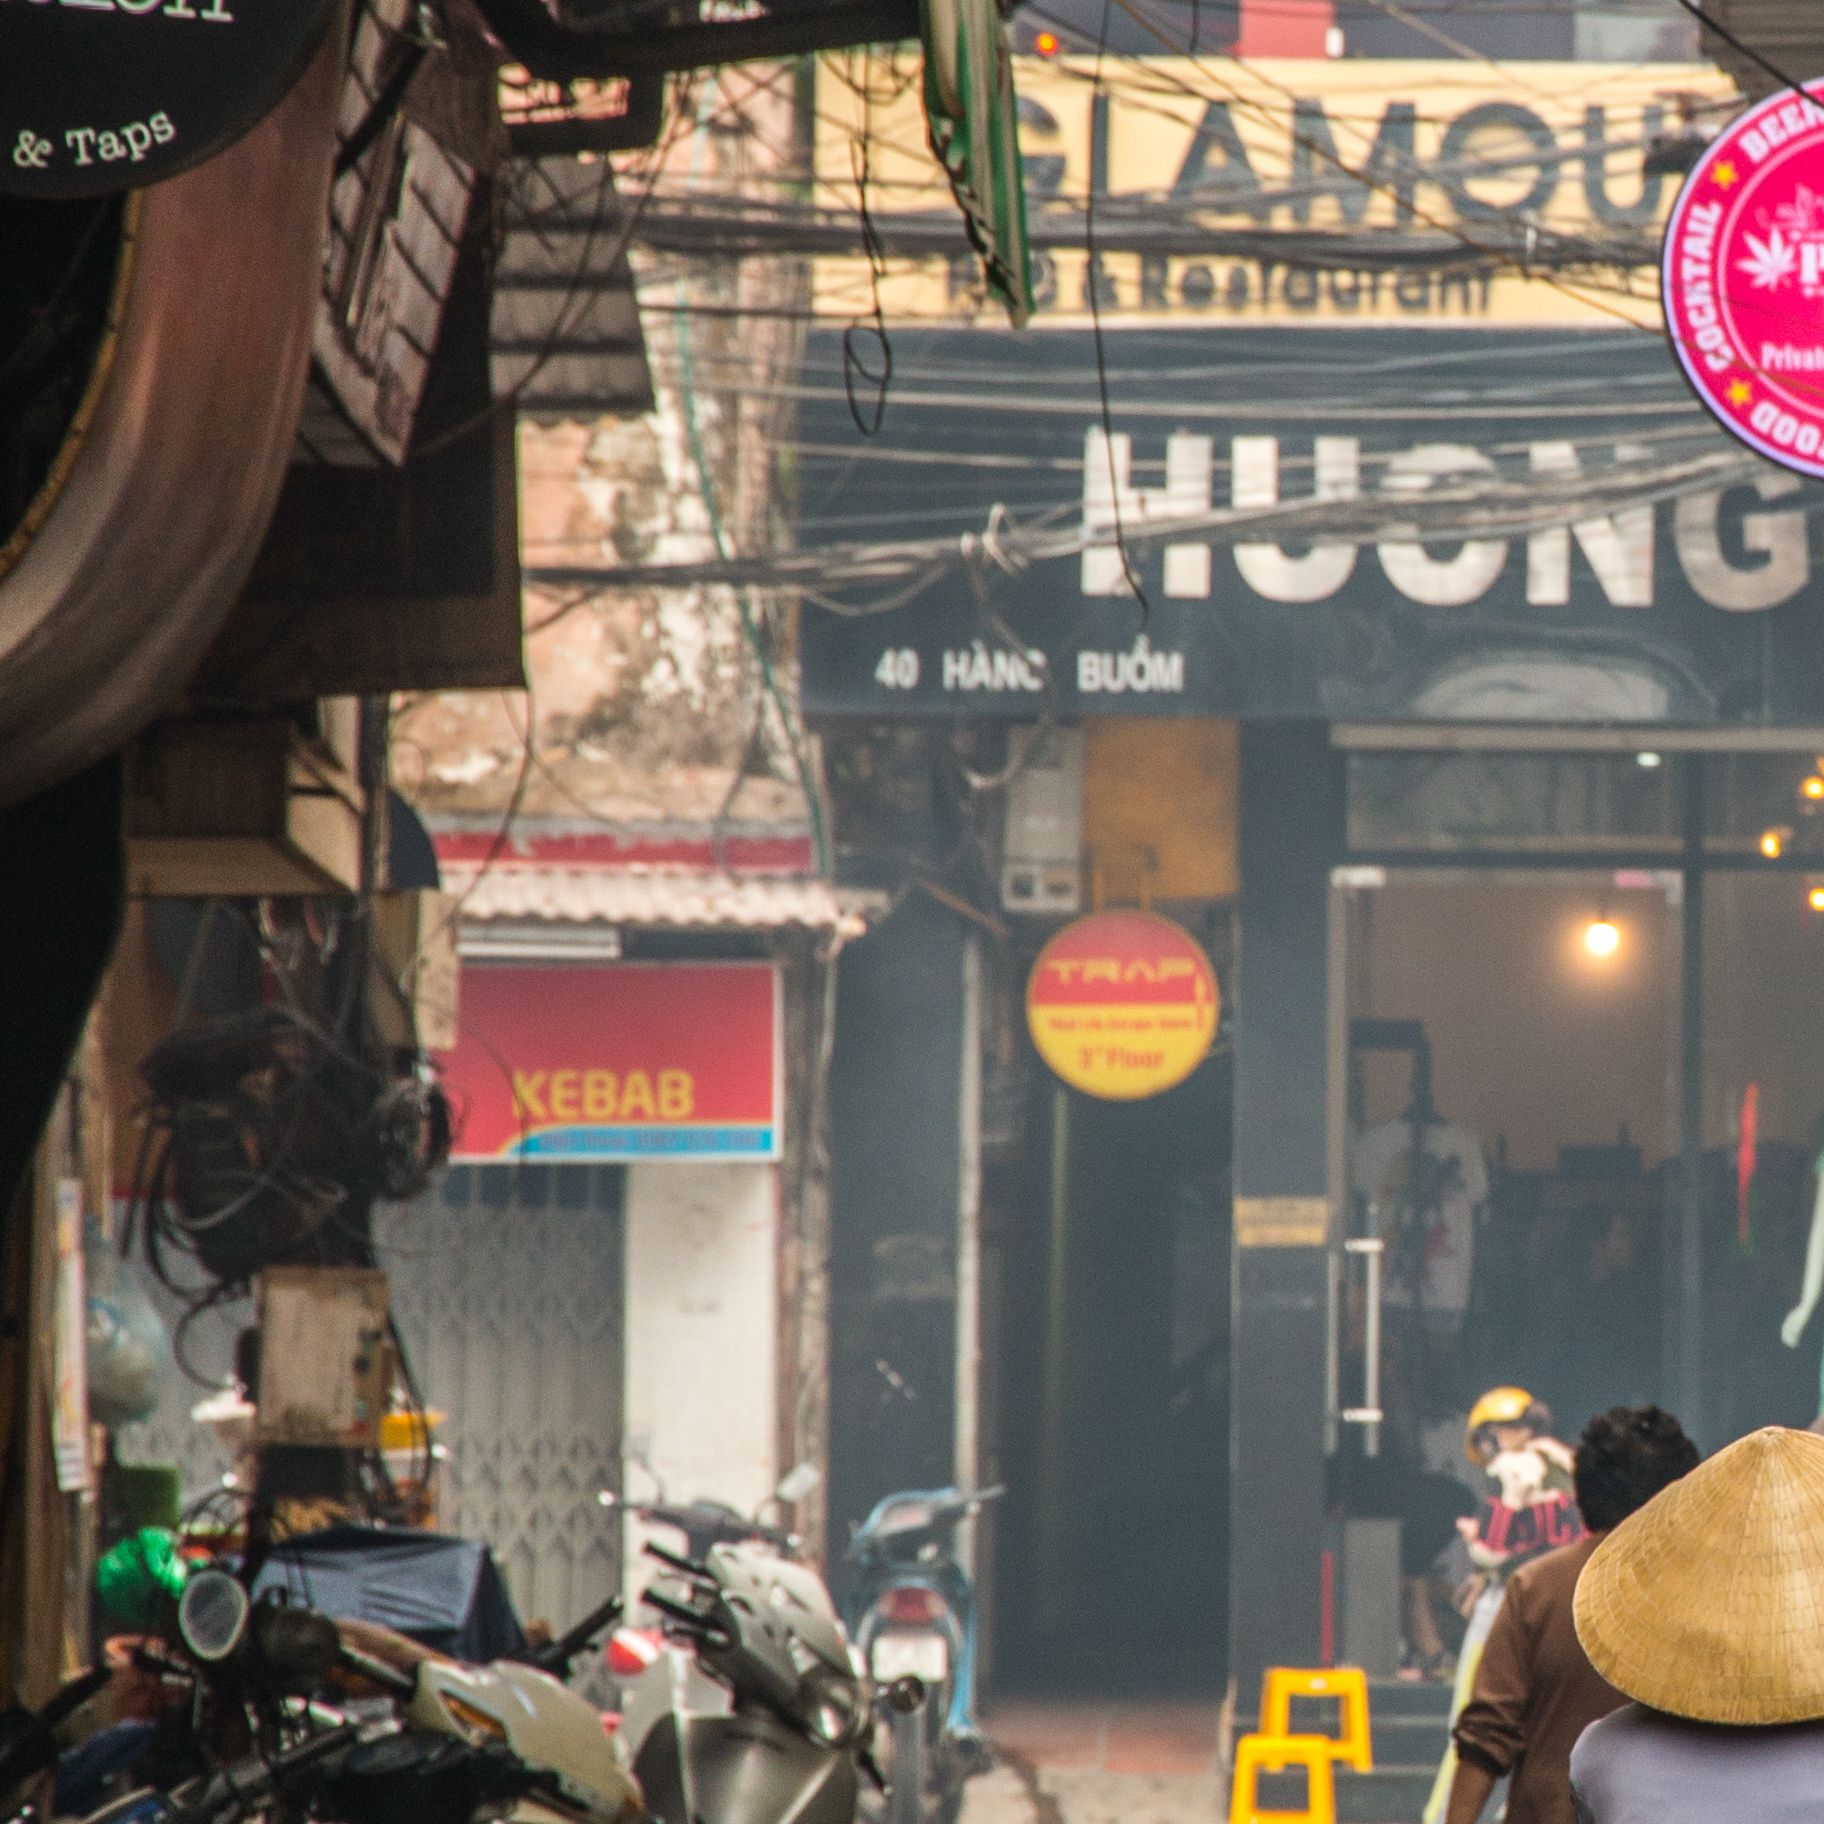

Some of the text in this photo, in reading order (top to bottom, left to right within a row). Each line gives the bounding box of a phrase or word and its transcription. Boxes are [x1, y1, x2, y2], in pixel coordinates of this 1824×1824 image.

[13, 111, 176, 169] & Taps
[1681, 199, 1734, 373] COCKTAIL
[874, 646, 921, 690] 40
[512, 1069, 695, 1120] KEBAB
